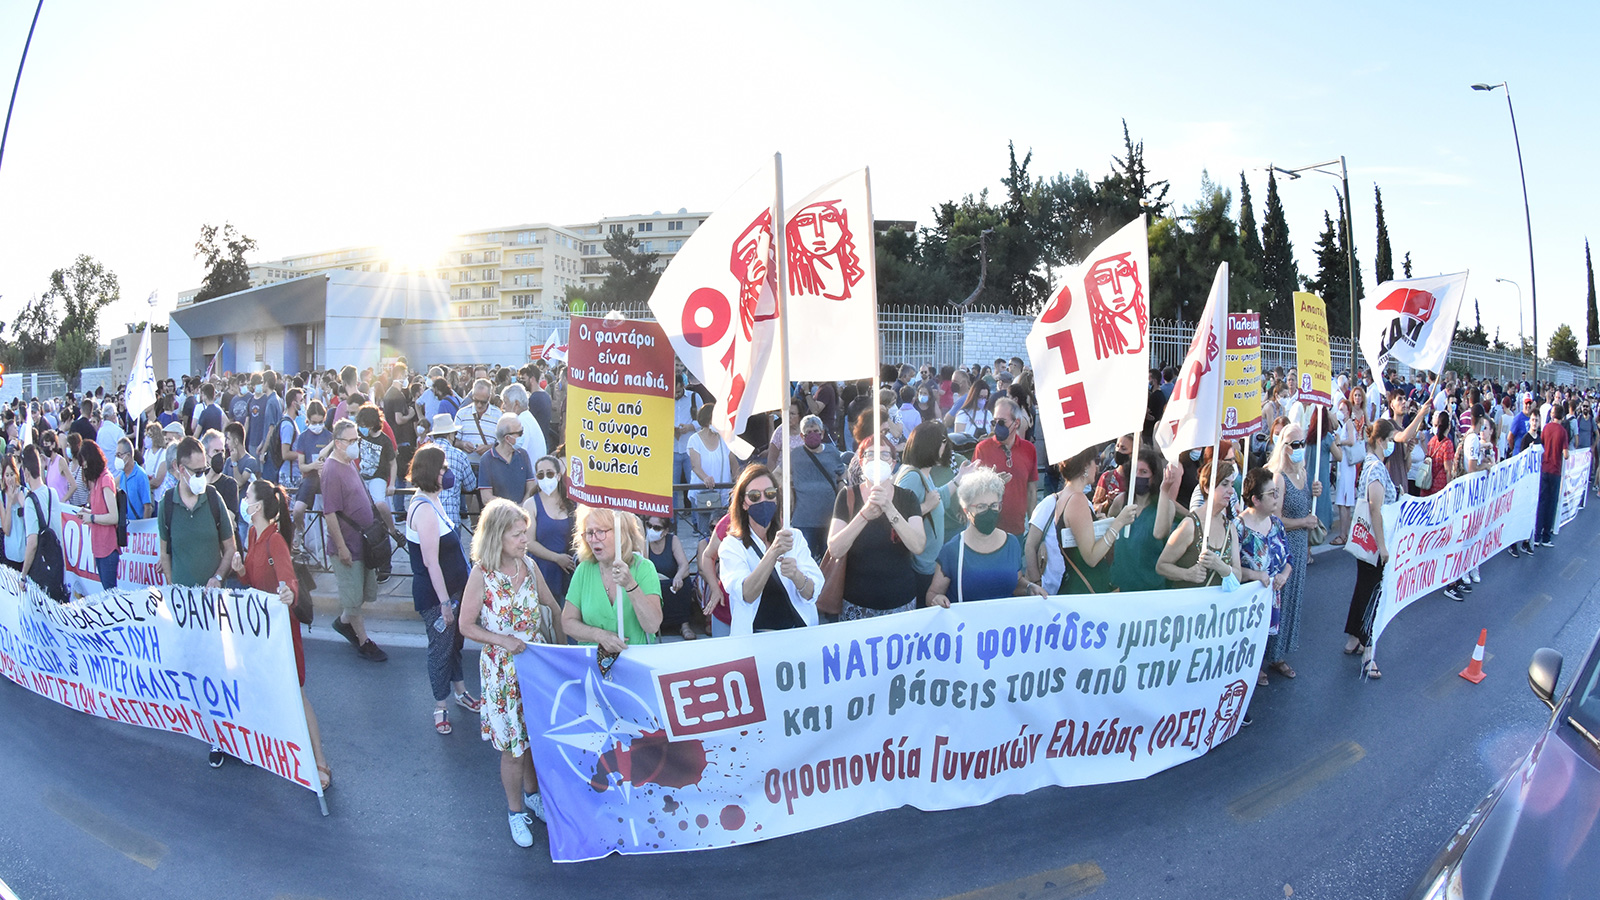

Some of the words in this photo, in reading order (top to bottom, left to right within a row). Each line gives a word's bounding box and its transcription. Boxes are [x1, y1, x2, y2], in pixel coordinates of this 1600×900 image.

[579, 323, 591, 341] Οι
[595, 328, 655, 349] φαντάροι
[598, 350, 631, 366] είναι
[570, 367, 585, 382] του
[588, 367, 619, 386] λαού
[624, 371, 669, 391] παιδιά,
[586, 397, 611, 415] έξω
[617, 401, 642, 416] από
[581, 417, 594, 432] τα
[598, 418, 648, 437] σύνορα
[579, 434, 598, 451] δεν
[604, 439, 651, 458] έχουνε
[588, 455, 639, 476] δουλειά
[568, 486, 602, 504] ΟΜΟΣΠΟΝΔΙΑ
[604, 496, 637, 510] ΓΥΝΑΙΚΩΝ
[638, 501, 670, 514] ΕΛΛΑΔΑΣ
[63, 520, 99, 575] ΟΧ
[129, 561, 164, 586] ΘΑΝΑΤΟ
[170, 586, 271, 639] ΘΑΝΑΤΟΥ
[56, 625, 162, 664] ΣΥΜΜΕΤΟΧΗ
[821, 622, 966, 684] ΝΑΤΟϊκοί
[977, 611, 1109, 669] φονιάδες
[1117, 595, 1265, 658] ιμπεριαλιστές
[14, 634, 70, 676] ΣΧΕΔΙΑ
[669, 670, 755, 727] ΕΞΩ
[783, 704, 833, 737] και
[888, 668, 997, 716] βάσεις
[1007, 666, 1067, 704] τους
[1075, 655, 1127, 696] από
[1137, 658, 1181, 691] την
[1186, 637, 1257, 684] Ελλάδα
[930, 723, 1043, 784] Γυναικών
[1045, 717, 1144, 763] Ελλάδας
[1147, 707, 1208, 754] (ΟΓΕ)
